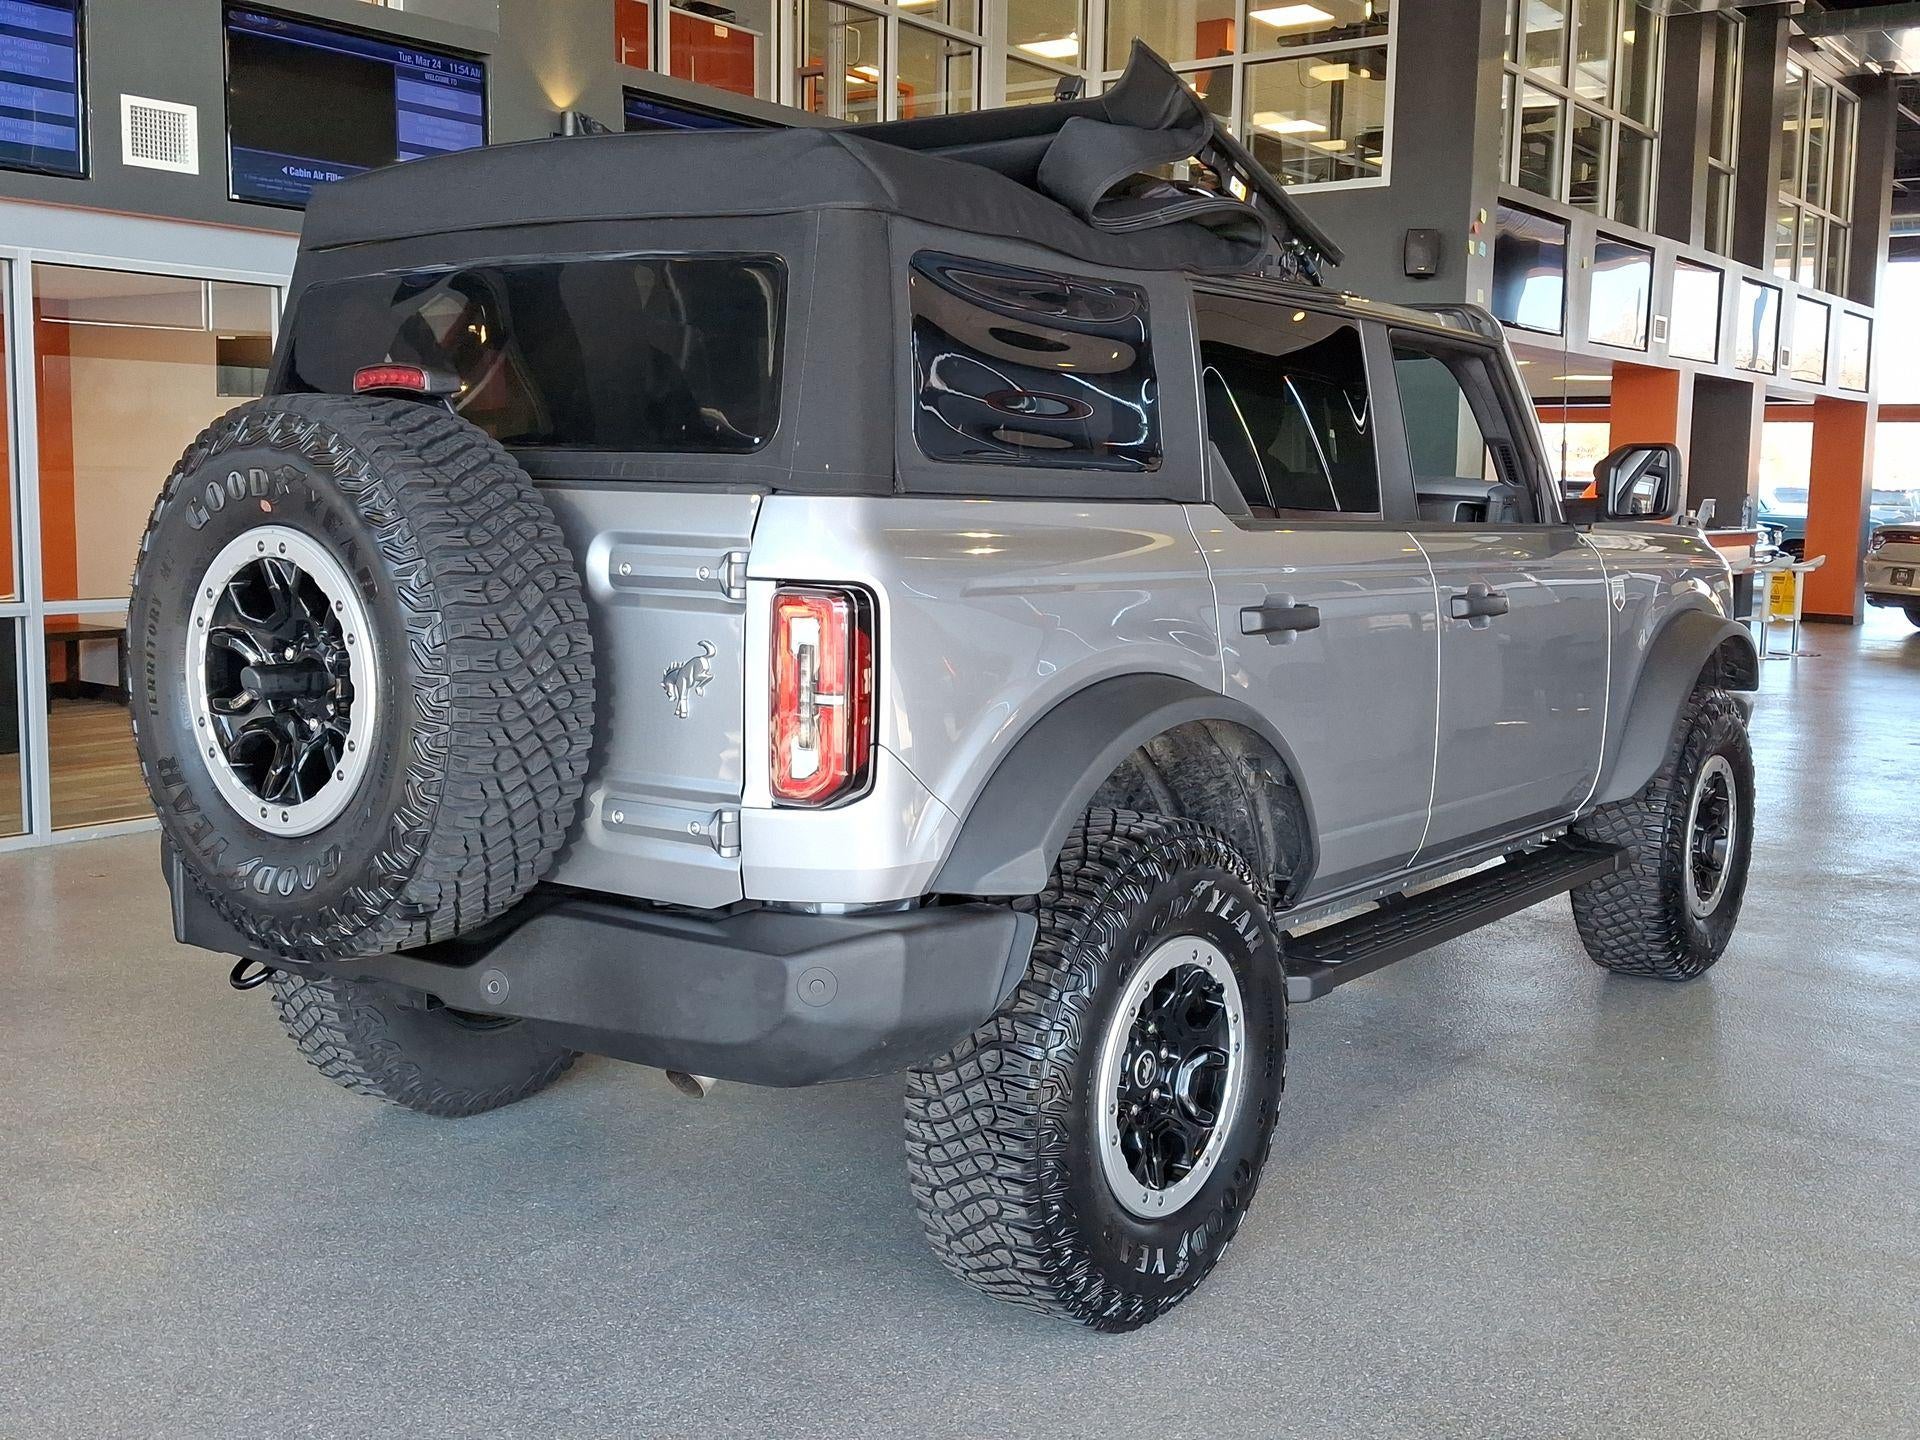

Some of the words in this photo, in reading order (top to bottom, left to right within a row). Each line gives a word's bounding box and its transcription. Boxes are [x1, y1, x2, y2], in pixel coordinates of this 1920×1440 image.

[398, 51, 414, 64] Tue,
[415, 55, 430, 67] Mar
[432, 59, 441, 69] 24
[449, 63, 469, 75] 11:54
[289, 166, 312, 179] Cabin
[313, 170, 324, 180] Air
[146, 593, 164, 718] TERRITORY
